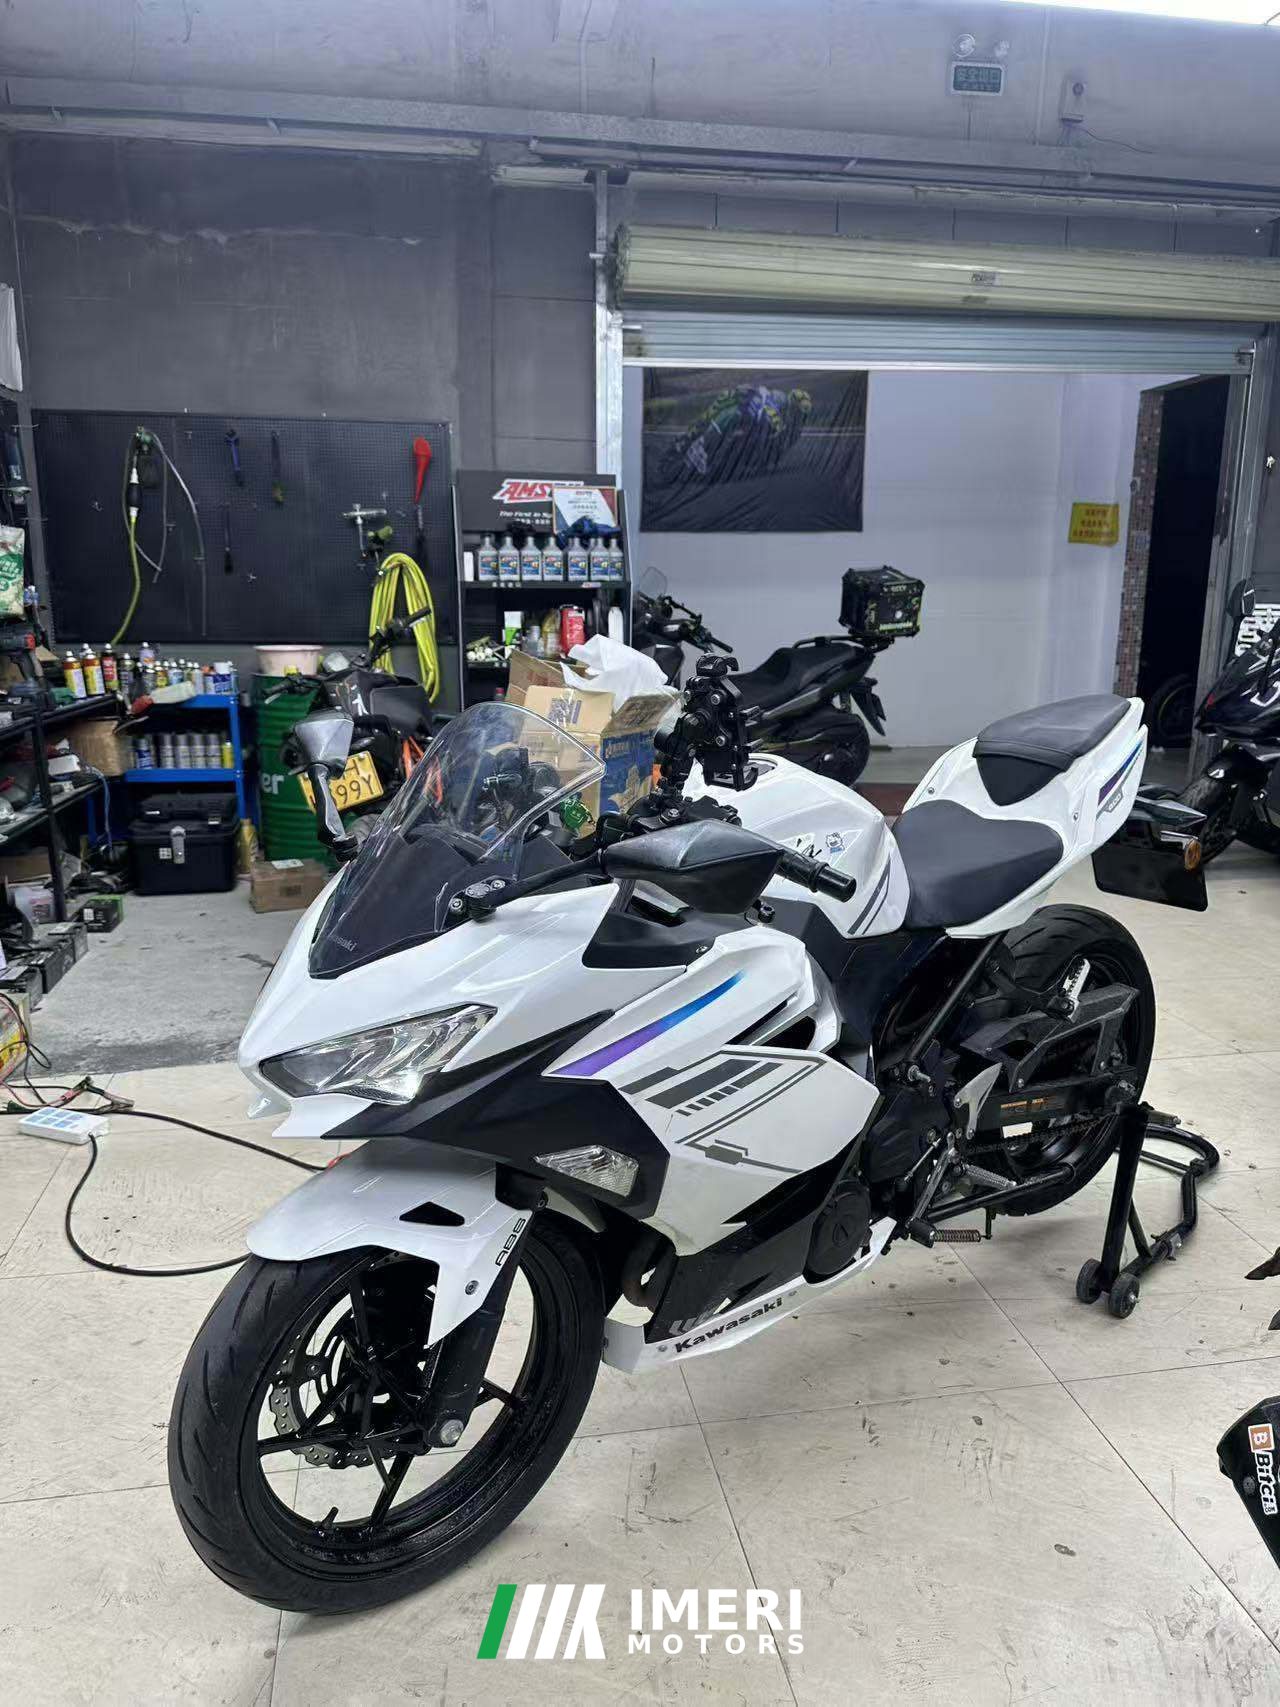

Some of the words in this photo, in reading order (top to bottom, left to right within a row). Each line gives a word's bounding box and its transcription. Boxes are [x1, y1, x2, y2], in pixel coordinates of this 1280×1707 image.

[262, 774, 284, 795] er
[494, 1217, 526, 1266] ABS
[674, 1297, 783, 1353] Kawasaki
